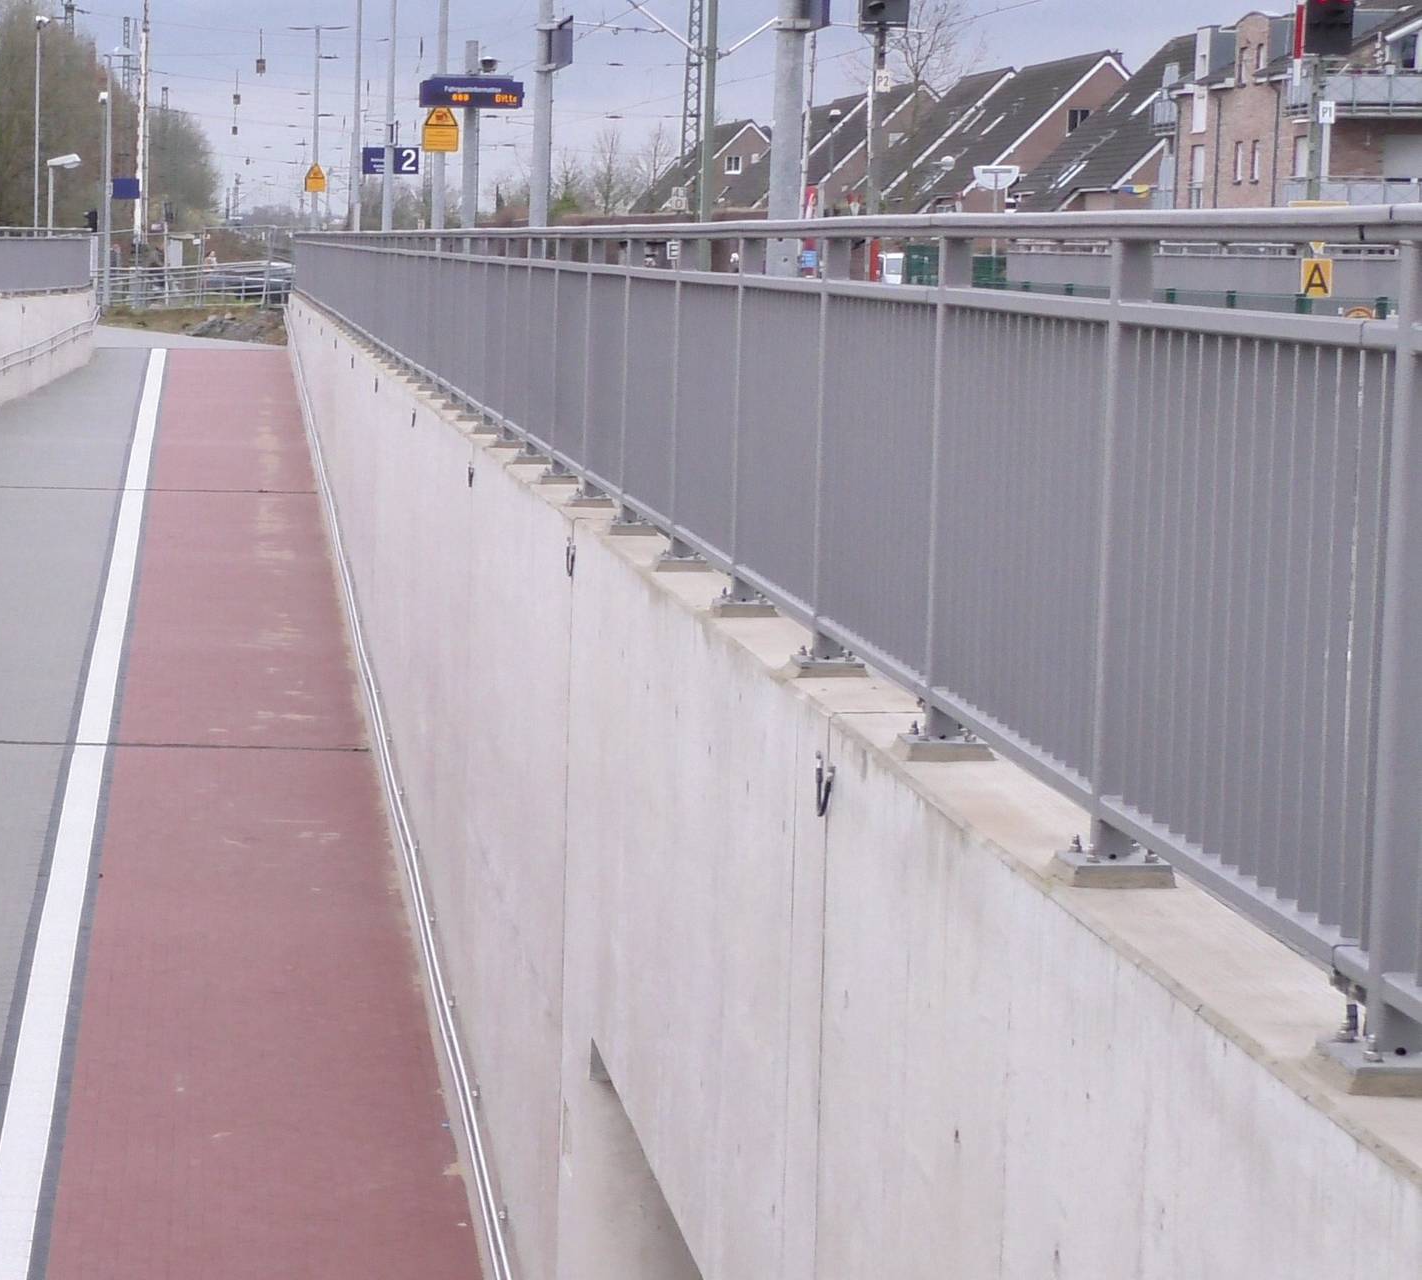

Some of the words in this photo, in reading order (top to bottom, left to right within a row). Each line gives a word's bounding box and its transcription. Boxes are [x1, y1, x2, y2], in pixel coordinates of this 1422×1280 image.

[877, 75, 889, 87] P2
[1321, 106, 1332, 118] P1
[401, 149, 416, 171] 2
[1305, 263, 1328, 294] A
